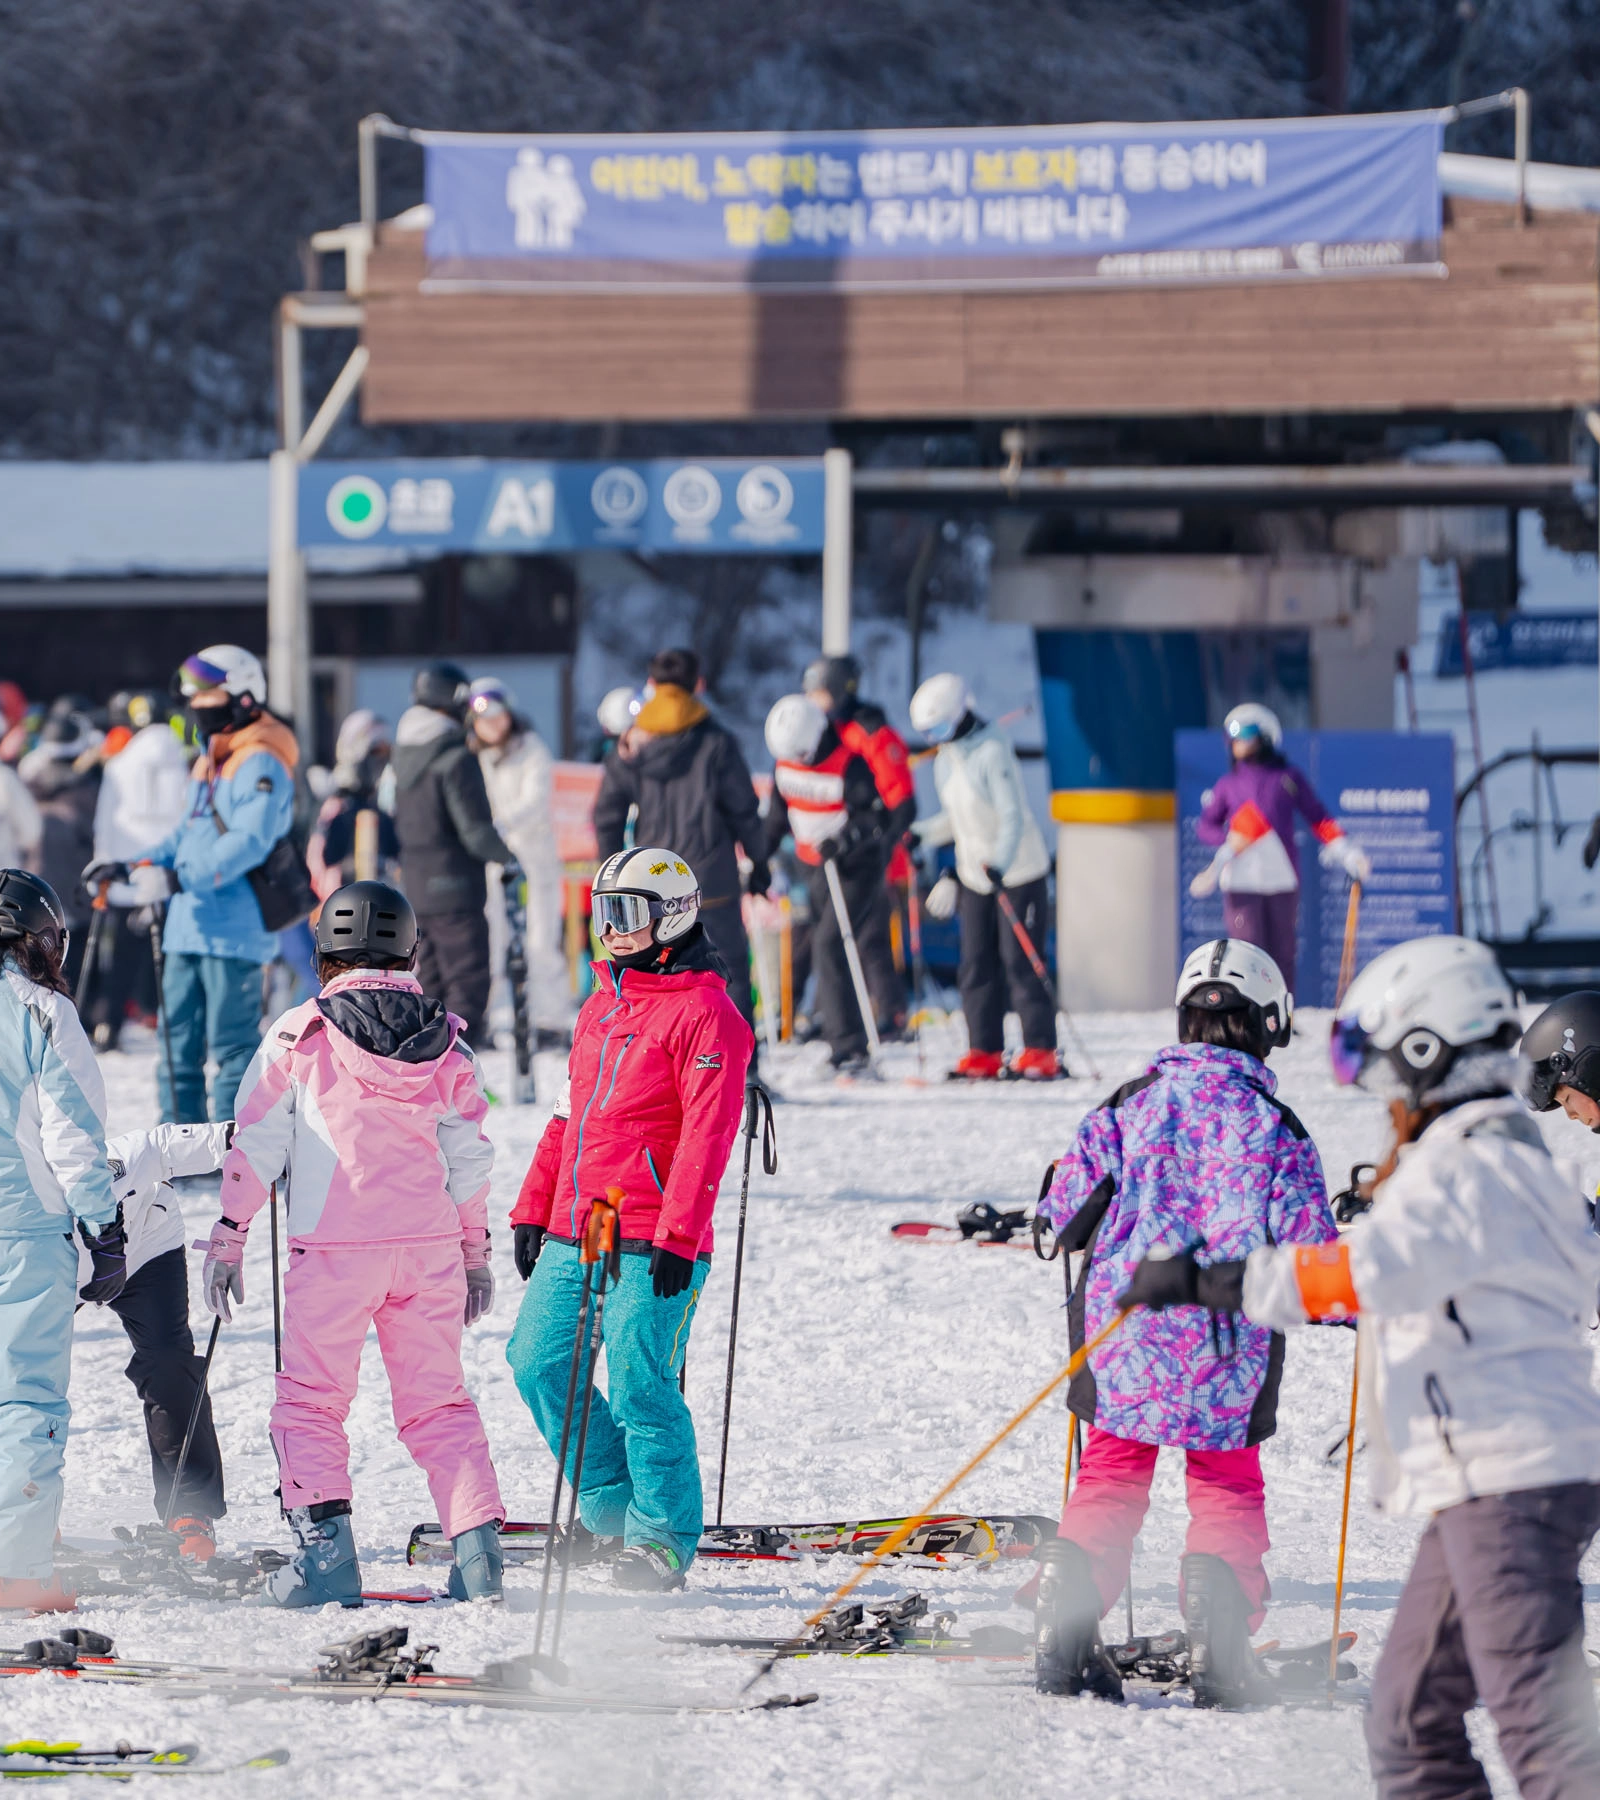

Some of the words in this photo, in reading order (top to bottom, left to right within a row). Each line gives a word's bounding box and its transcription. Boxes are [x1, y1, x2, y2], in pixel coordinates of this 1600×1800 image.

[591, 153, 709, 203] 어린이,
[713, 151, 851, 199] 노약자는
[858, 148, 967, 198] 반드시
[970, 145, 1115, 194] 보호자와
[1121, 139, 1268, 193] 동승하여
[869, 196, 979, 246] 주시기
[982, 193, 1129, 244] 바랍니다
[487, 478, 554, 537] A1
[928, 1532, 958, 1541] elan
